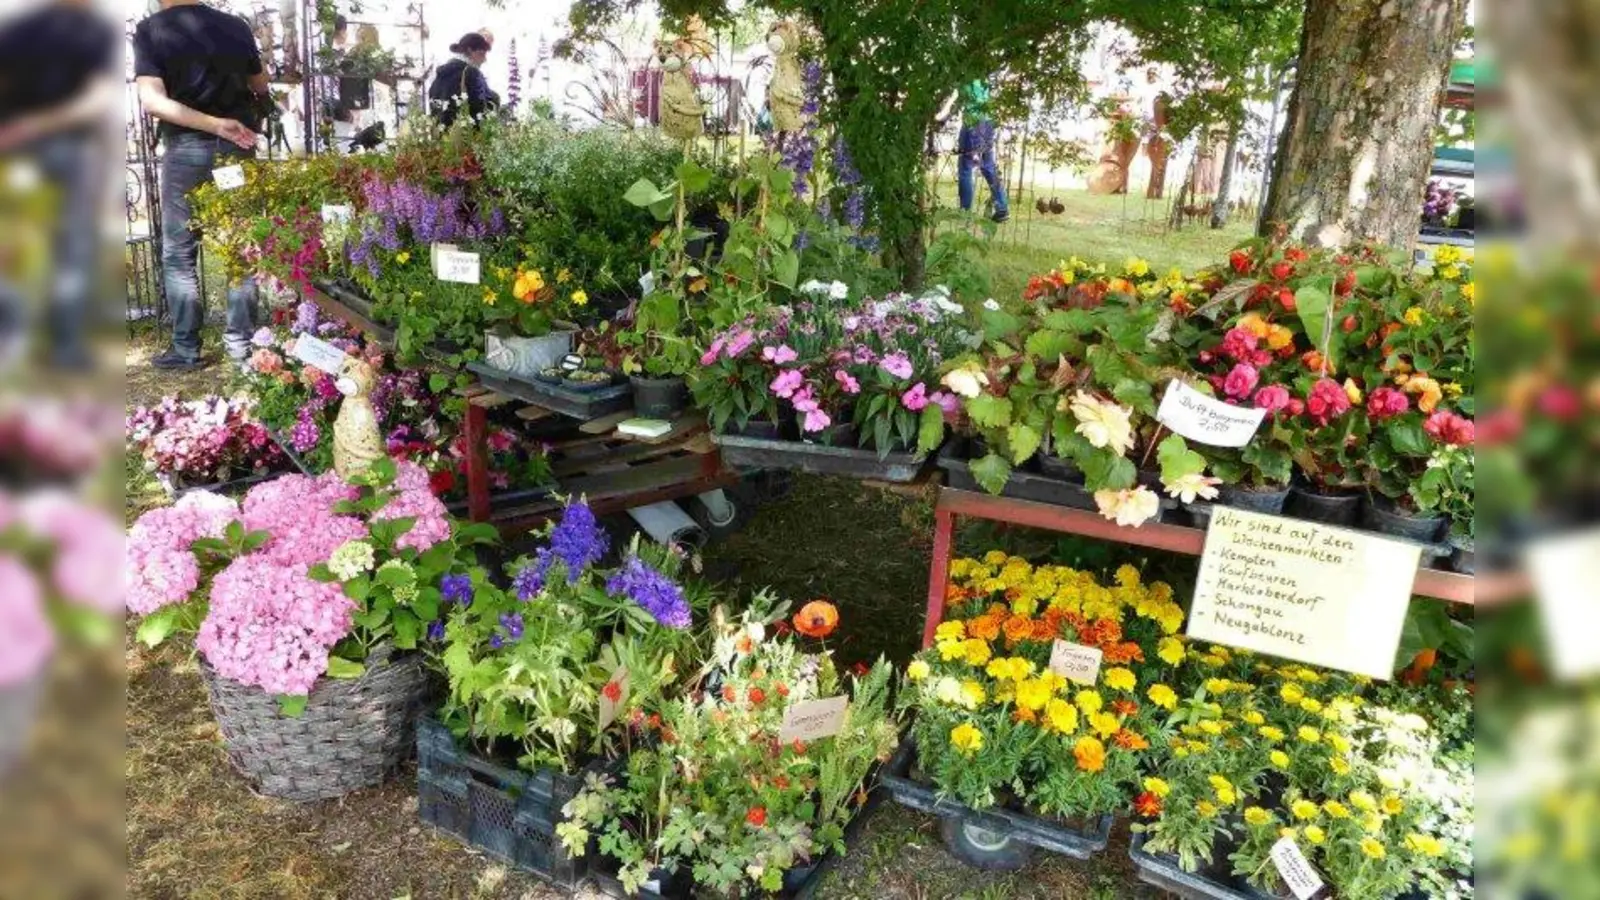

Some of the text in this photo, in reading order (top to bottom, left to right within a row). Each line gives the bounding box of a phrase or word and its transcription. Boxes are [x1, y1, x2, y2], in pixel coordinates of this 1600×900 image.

[1215, 511, 1355, 551] Wir sind auf den
